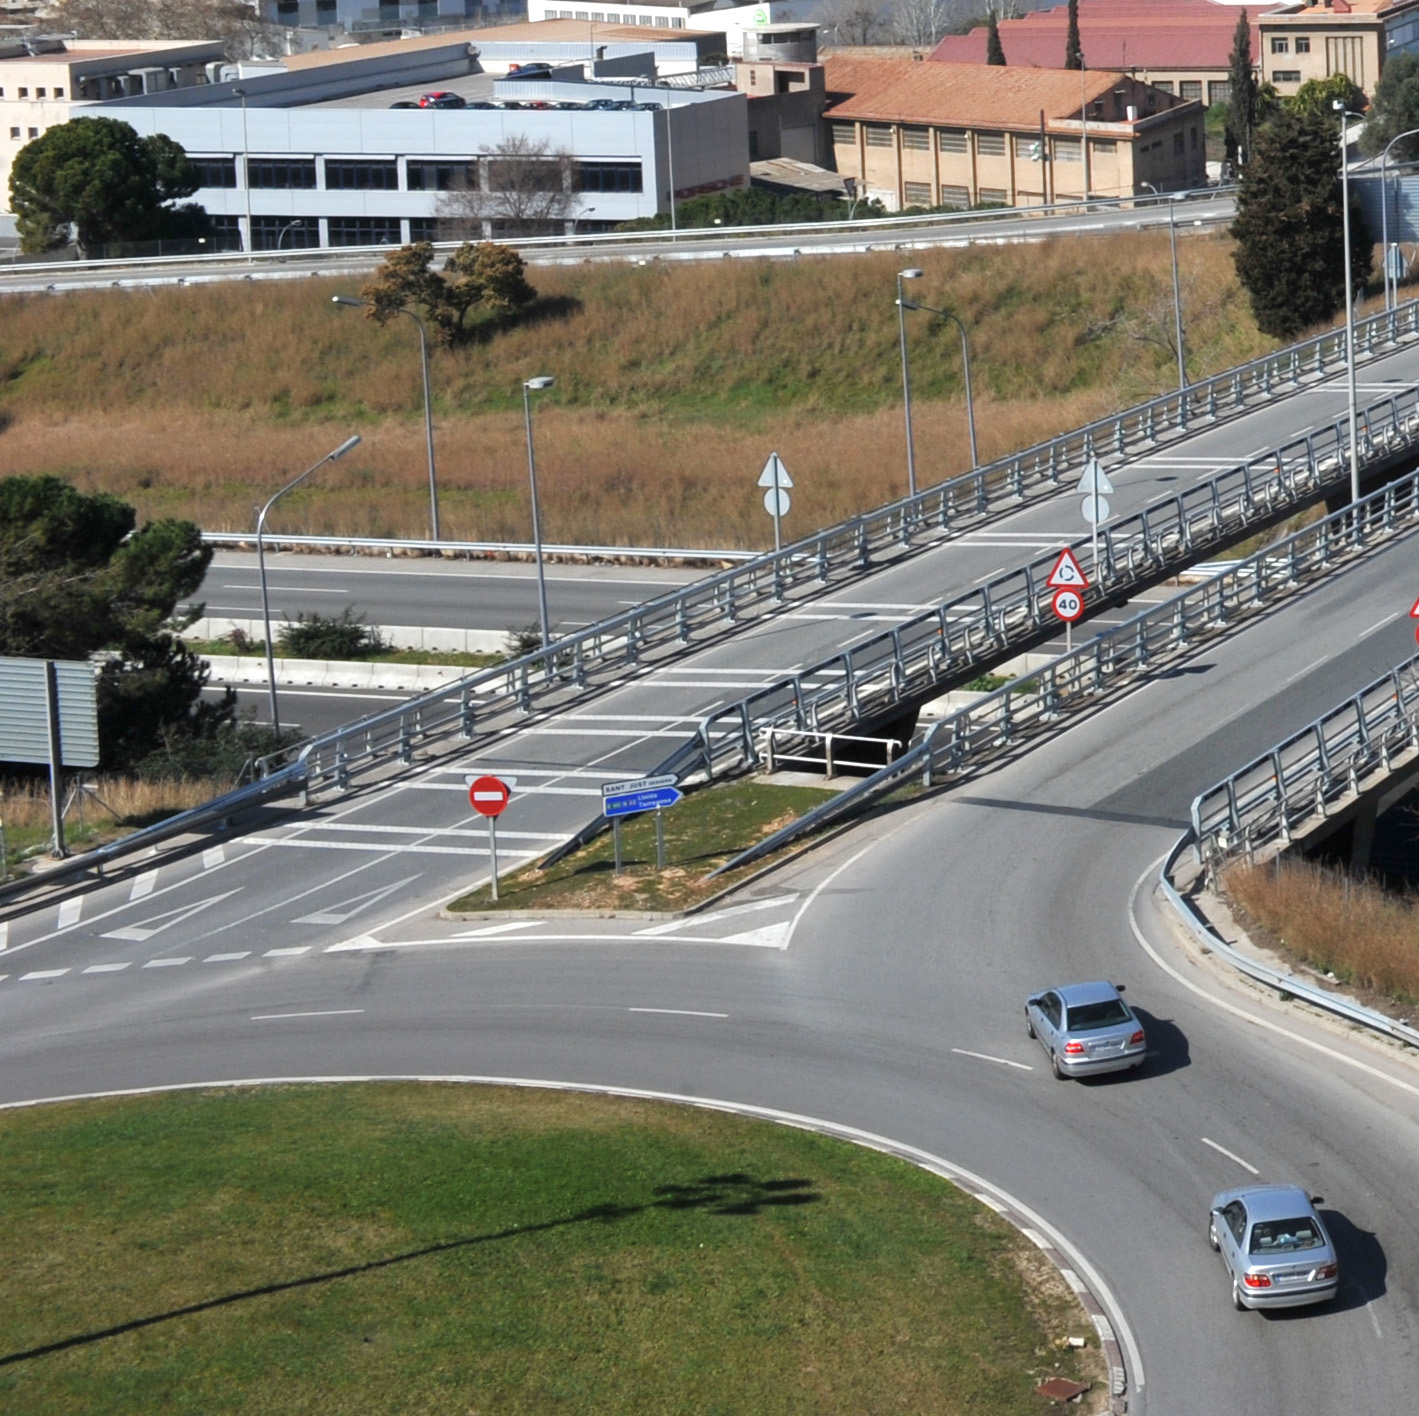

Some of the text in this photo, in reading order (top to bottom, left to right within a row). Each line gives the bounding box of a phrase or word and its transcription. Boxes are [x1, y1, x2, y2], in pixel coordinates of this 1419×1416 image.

[1059, 599, 1077, 610] 40
[606, 785, 625, 793] SANT
[629, 780, 647, 789] JUST
